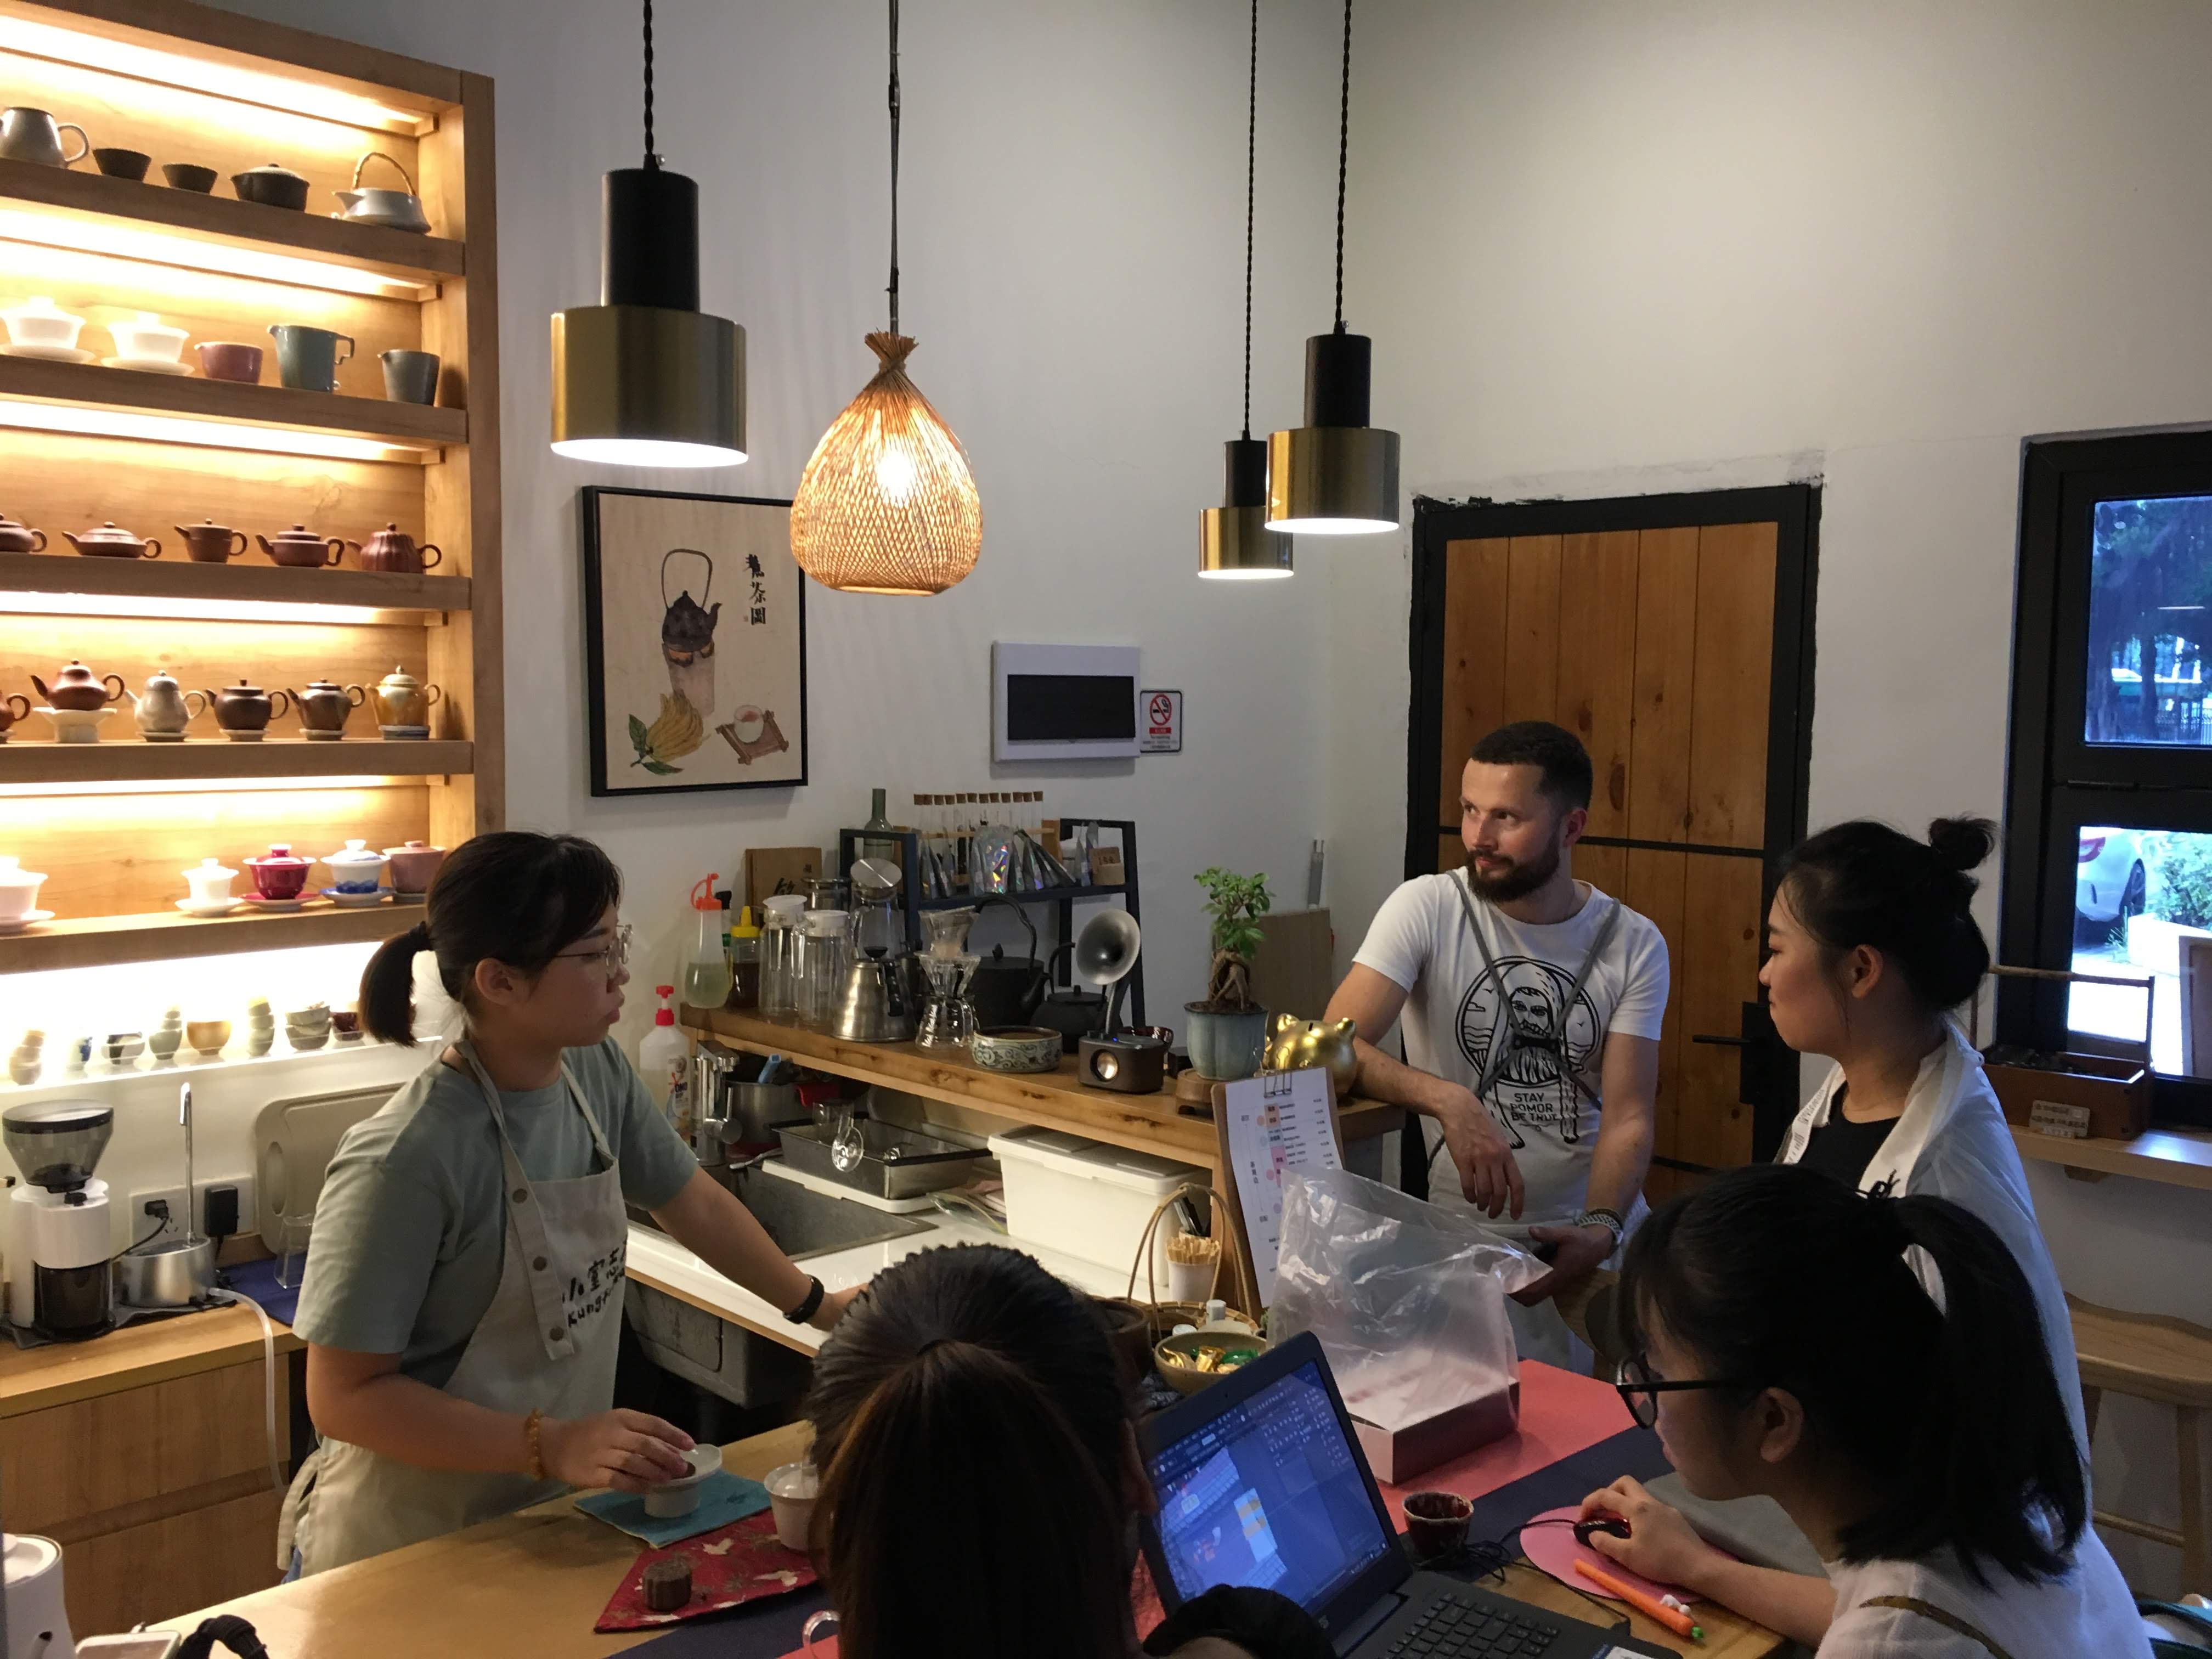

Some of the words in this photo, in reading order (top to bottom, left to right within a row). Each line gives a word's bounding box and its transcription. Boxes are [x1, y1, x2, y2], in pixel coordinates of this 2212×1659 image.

[1514, 1092, 1544, 1102] STAY
[1510, 1103, 1553, 1113] POMOR
[1511, 1111, 1526, 1121] BE
[1529, 1113, 1560, 1121] TRUE
